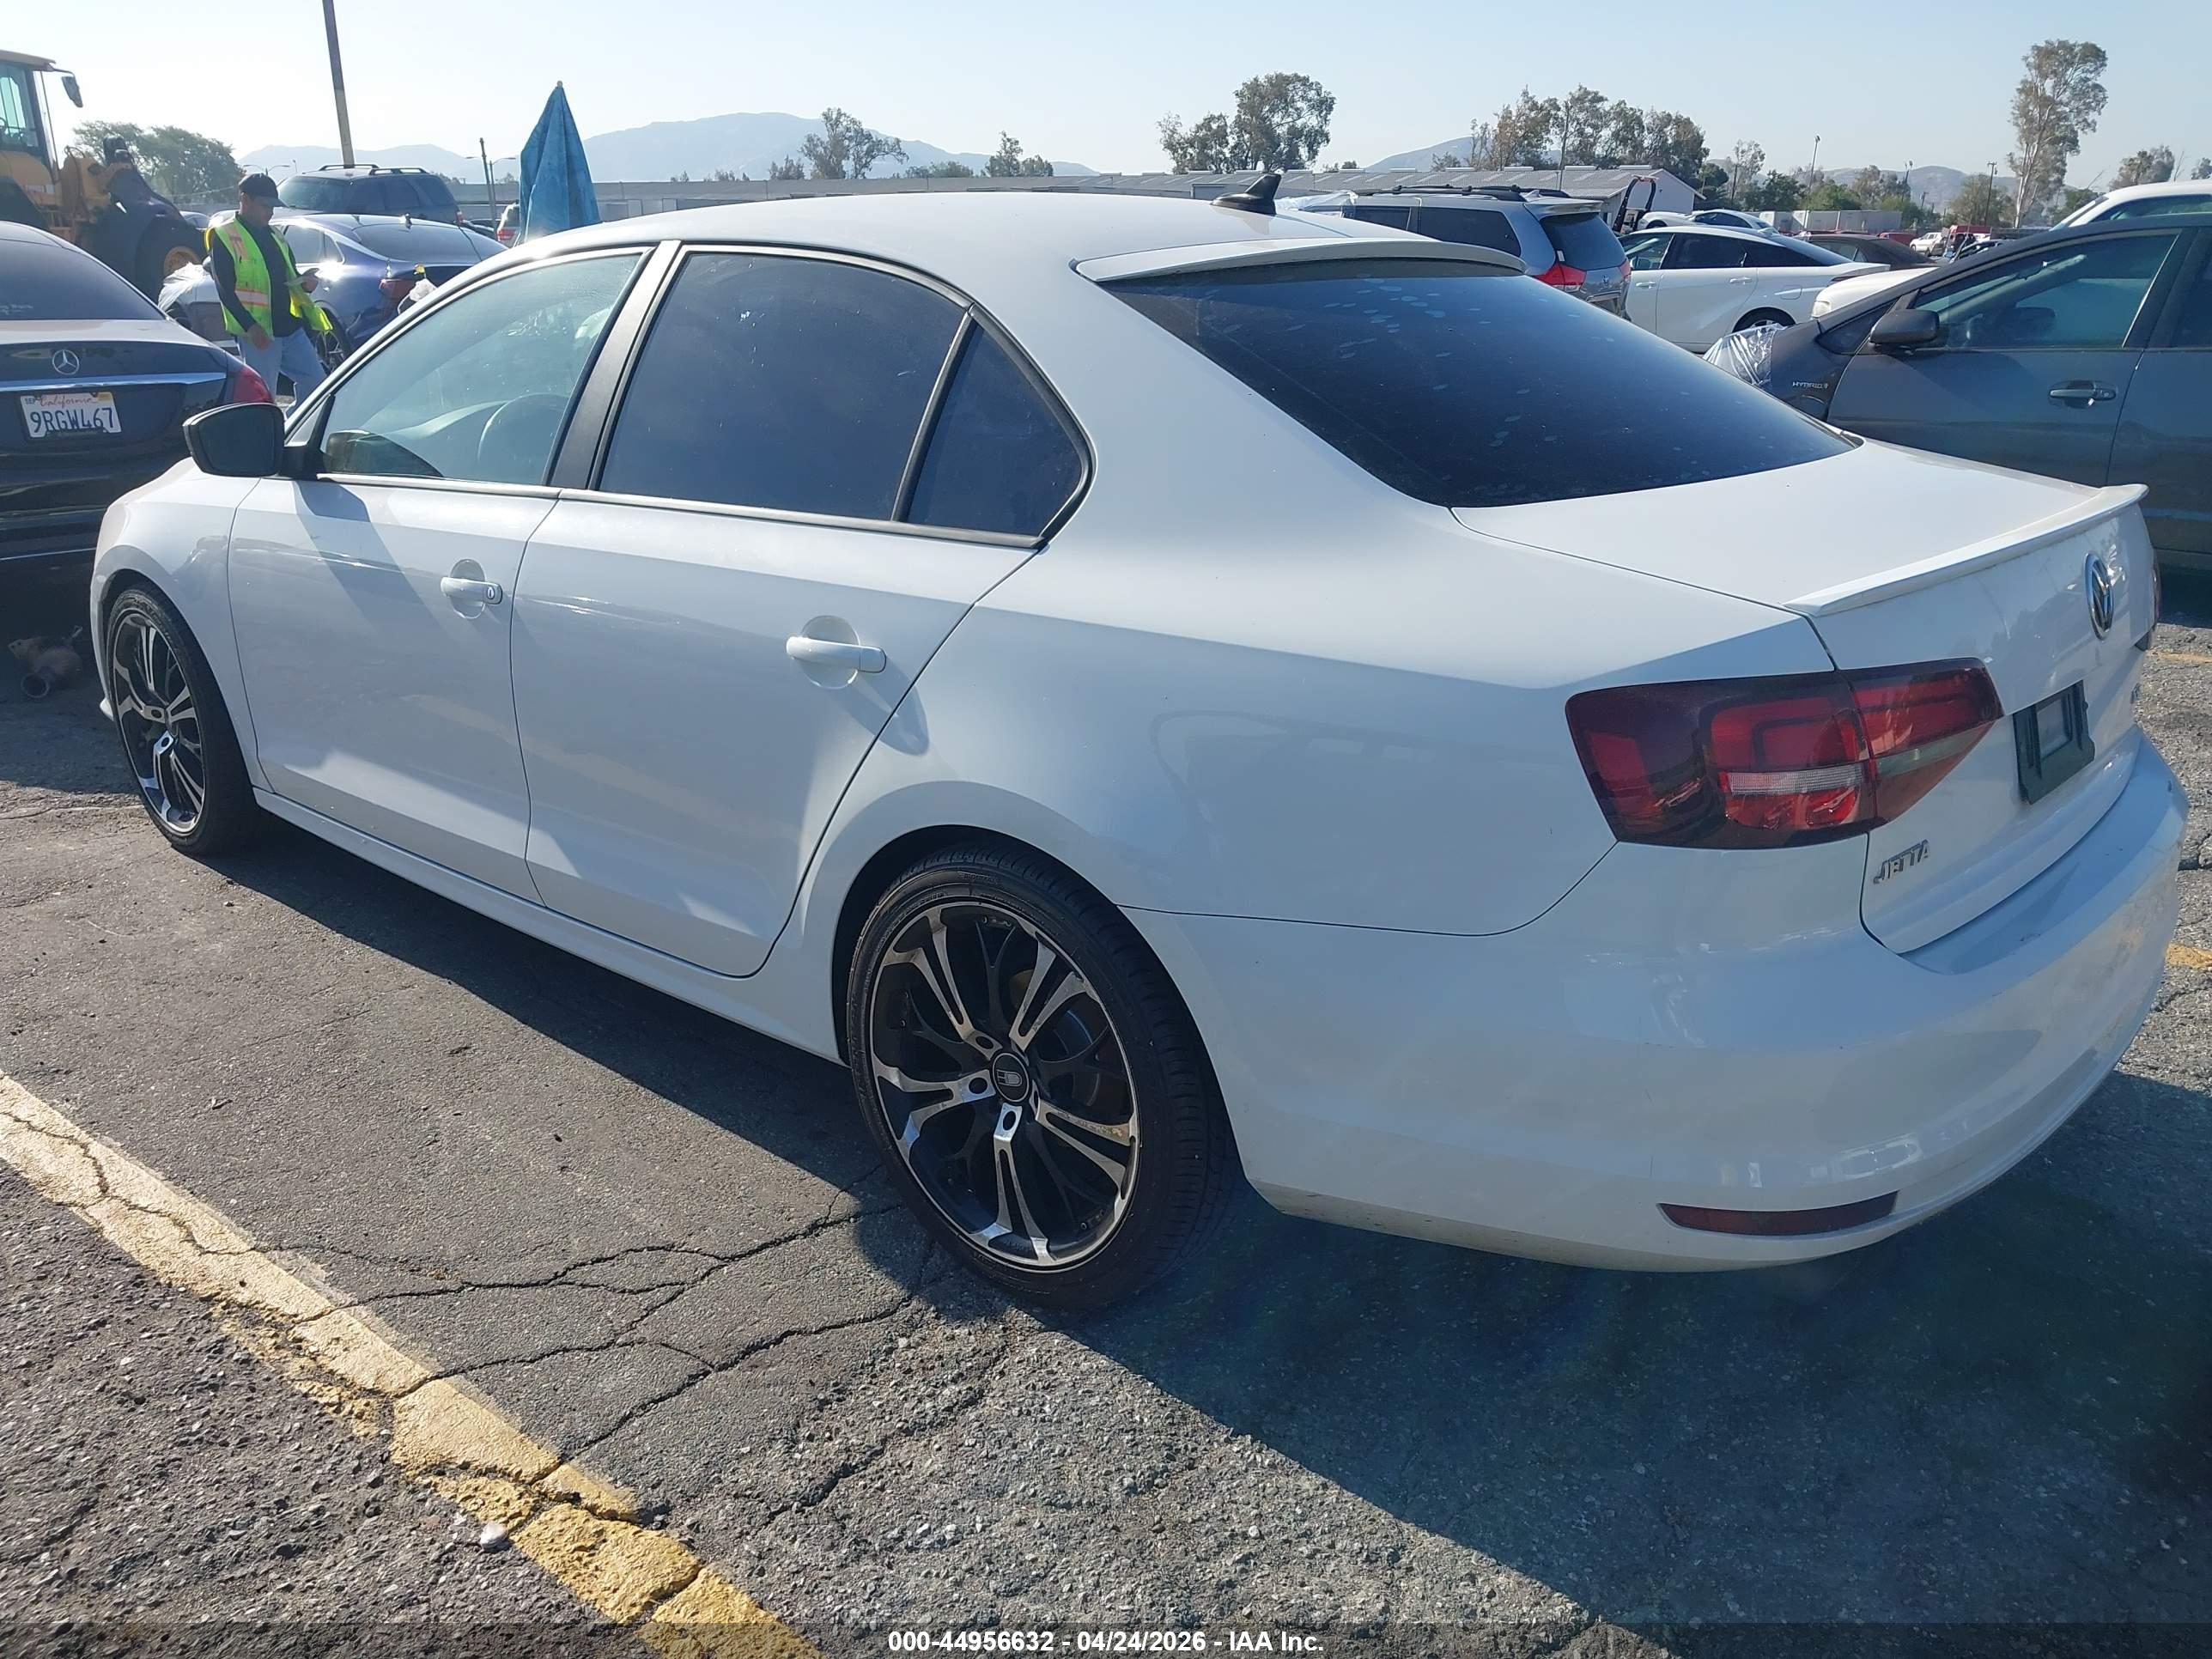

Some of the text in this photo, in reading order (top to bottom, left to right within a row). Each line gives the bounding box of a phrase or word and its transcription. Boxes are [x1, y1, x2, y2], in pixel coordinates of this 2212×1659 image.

[40, 394, 97, 408] California
[30, 408, 113, 433] 9RGW467
[1873, 839, 1929, 884] JETTA
